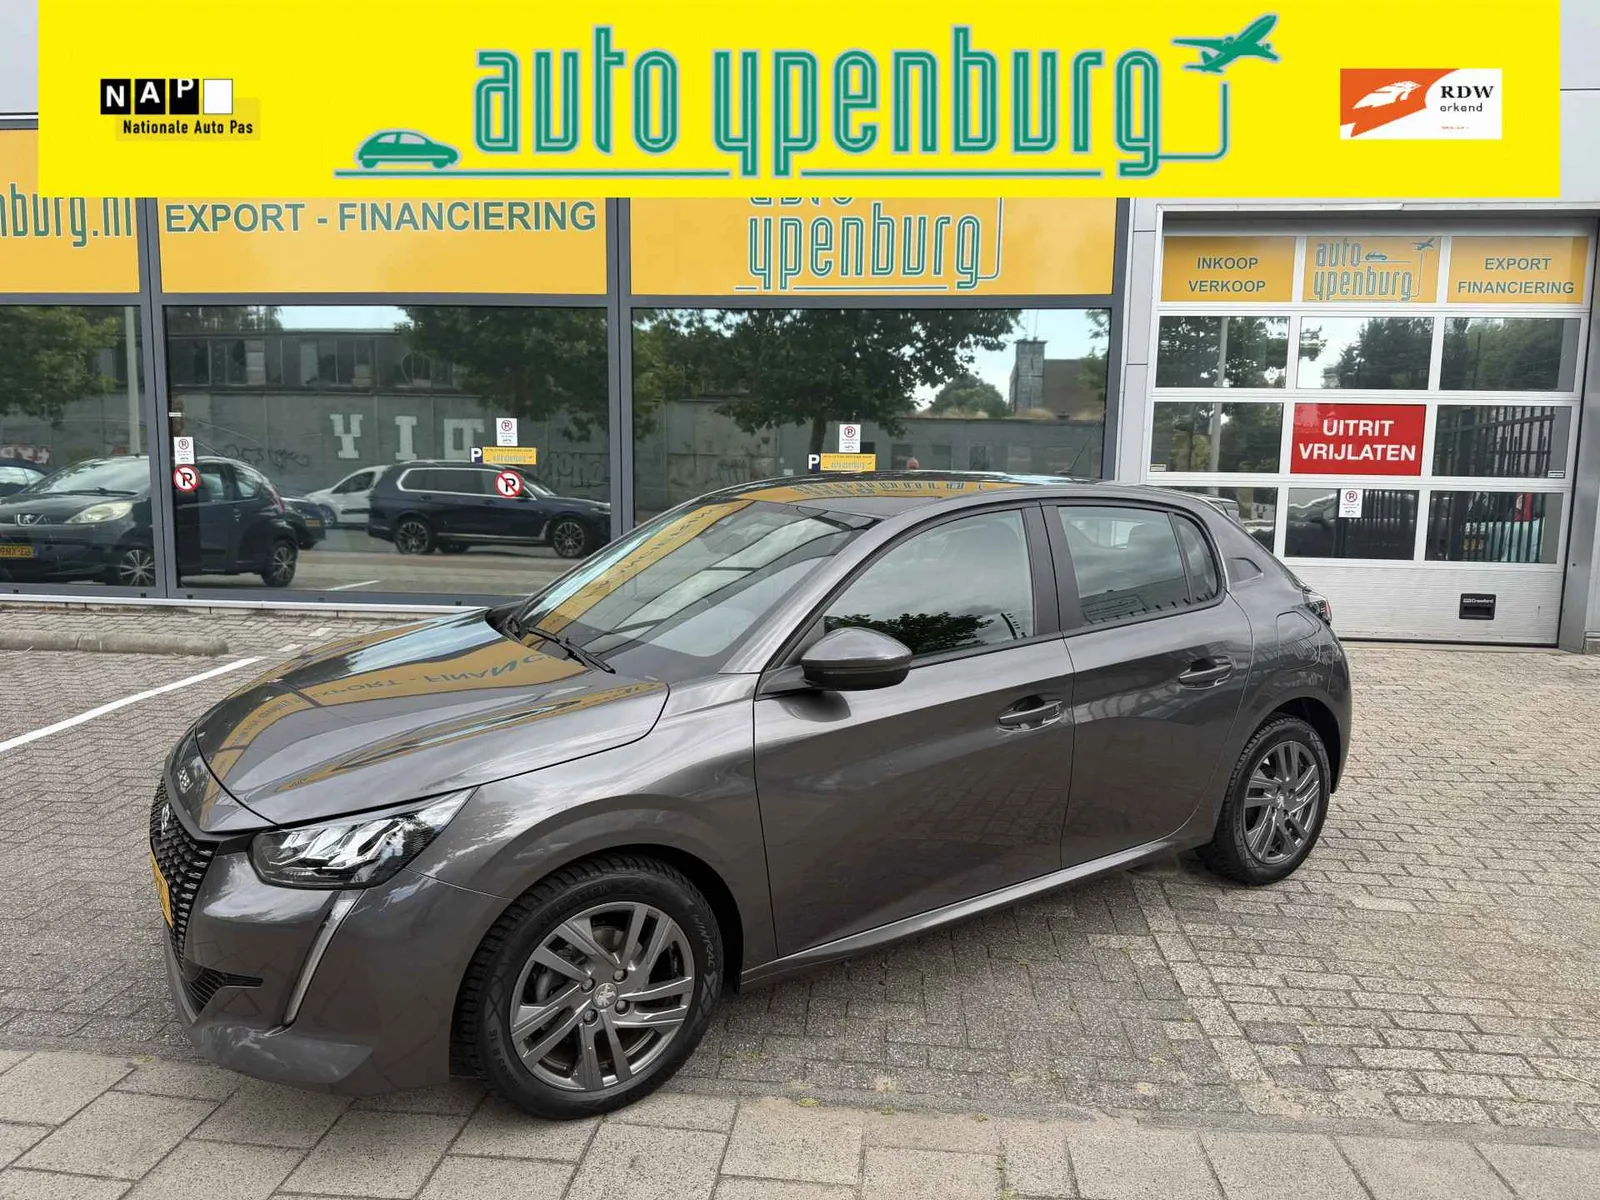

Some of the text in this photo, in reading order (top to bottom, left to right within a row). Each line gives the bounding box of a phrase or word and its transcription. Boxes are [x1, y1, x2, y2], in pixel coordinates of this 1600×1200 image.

[165, 203, 305, 232] EXPORT
[338, 201, 597, 232] FINANCIERING
[748, 201, 981, 291] ypenburg
[1315, 238, 1362, 267] auto
[1197, 257, 1259, 270] INKOOP
[1484, 257, 1552, 270] EXPORT
[1188, 280, 1266, 293] VERKOOP
[1313, 266, 1412, 301] ypenburg
[1457, 281, 1575, 294] FINANCIERING
[1322, 419, 1395, 437] UITRIT
[1298, 443, 1417, 461] VRIJLATEN
